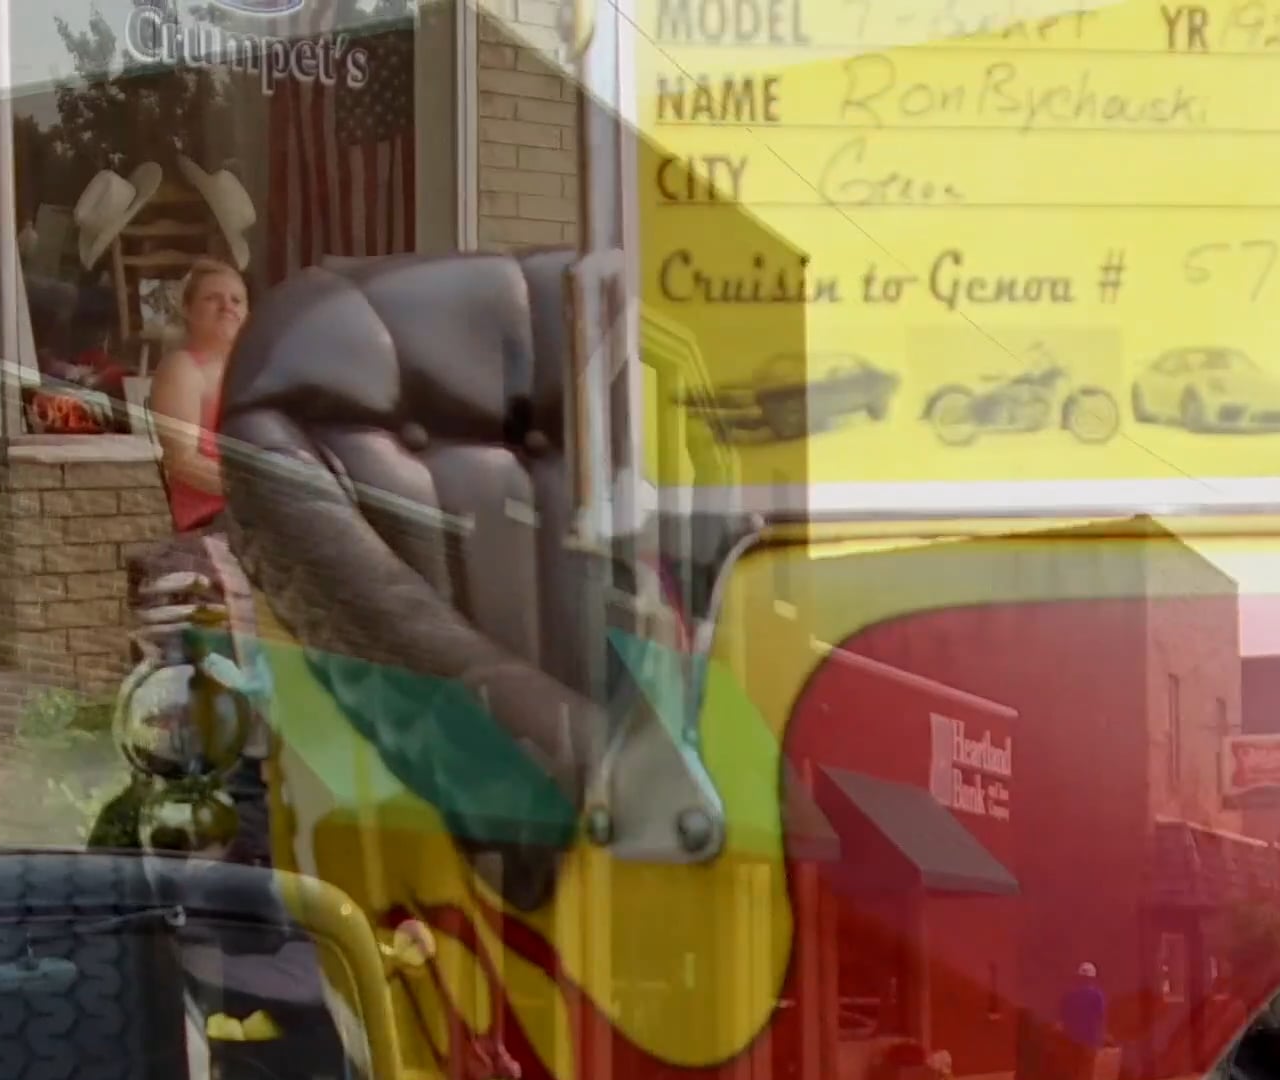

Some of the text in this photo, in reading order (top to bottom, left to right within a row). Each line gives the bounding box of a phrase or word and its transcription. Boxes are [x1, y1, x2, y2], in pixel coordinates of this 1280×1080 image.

[124, 5, 370, 97] Crumpet's
[656, 0, 810, 45] MODEL
[1160, 4, 1210, 51] YR
[656, 74, 782, 122] NAME
[656, 154, 748, 202] CITY
[658, 240, 1279, 311] Cruisin to Genoa # 57
[951, 718, 1012, 777] Heartland
[951, 766, 986, 816] Bank
